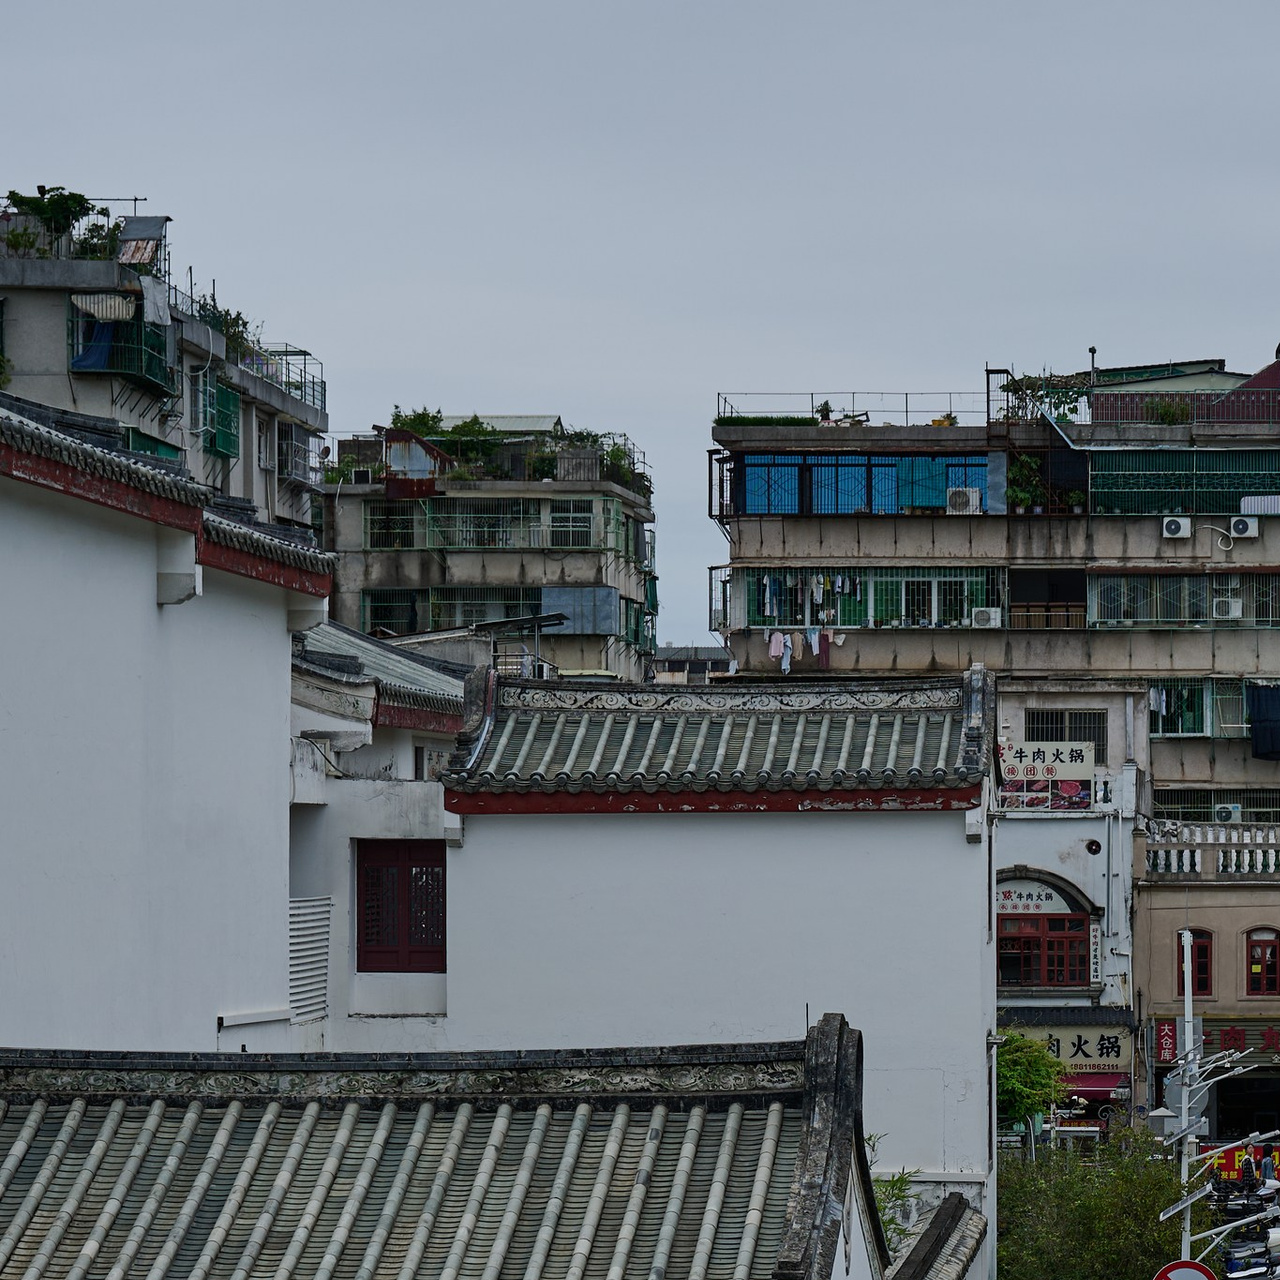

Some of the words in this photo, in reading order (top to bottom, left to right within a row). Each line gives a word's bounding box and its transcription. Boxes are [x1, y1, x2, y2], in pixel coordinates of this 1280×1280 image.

[1013, 748, 1084, 764] 牛肉火锅
[1160, 1024, 1173, 1061] 大仓库
